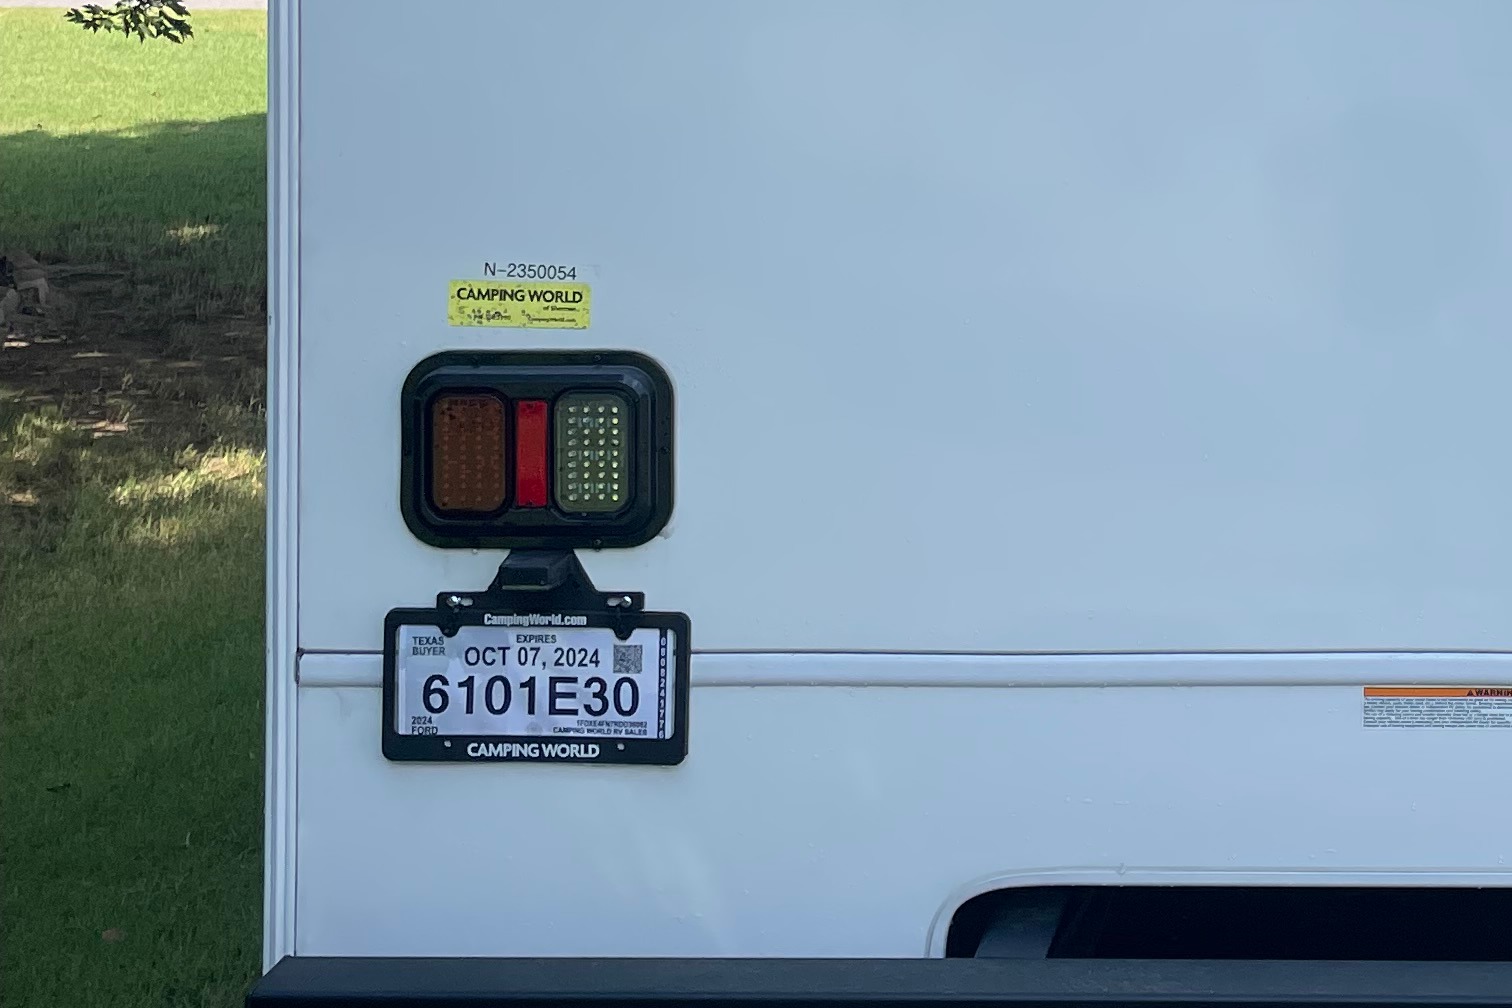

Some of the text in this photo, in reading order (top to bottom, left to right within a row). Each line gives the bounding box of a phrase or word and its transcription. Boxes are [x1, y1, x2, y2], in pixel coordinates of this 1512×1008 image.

[484, 262, 577, 280] N-2350054
[456, 288, 583, 303] CAMPING WORLD
[484, 613, 587, 627] CampingWorld.com
[412, 636, 445, 646] TEXAS
[516, 634, 557, 644] EXPIRES
[412, 647, 446, 656] BUYER
[464, 647, 600, 670] OCT 07, 2024
[422, 674, 640, 717] 6101E30
[411, 716, 433, 725] 2024
[411, 726, 439, 735] FORD
[613, 728, 624, 736] RV
[624, 728, 648, 736] SALES
[467, 743, 600, 758] CAMPING WORLD
